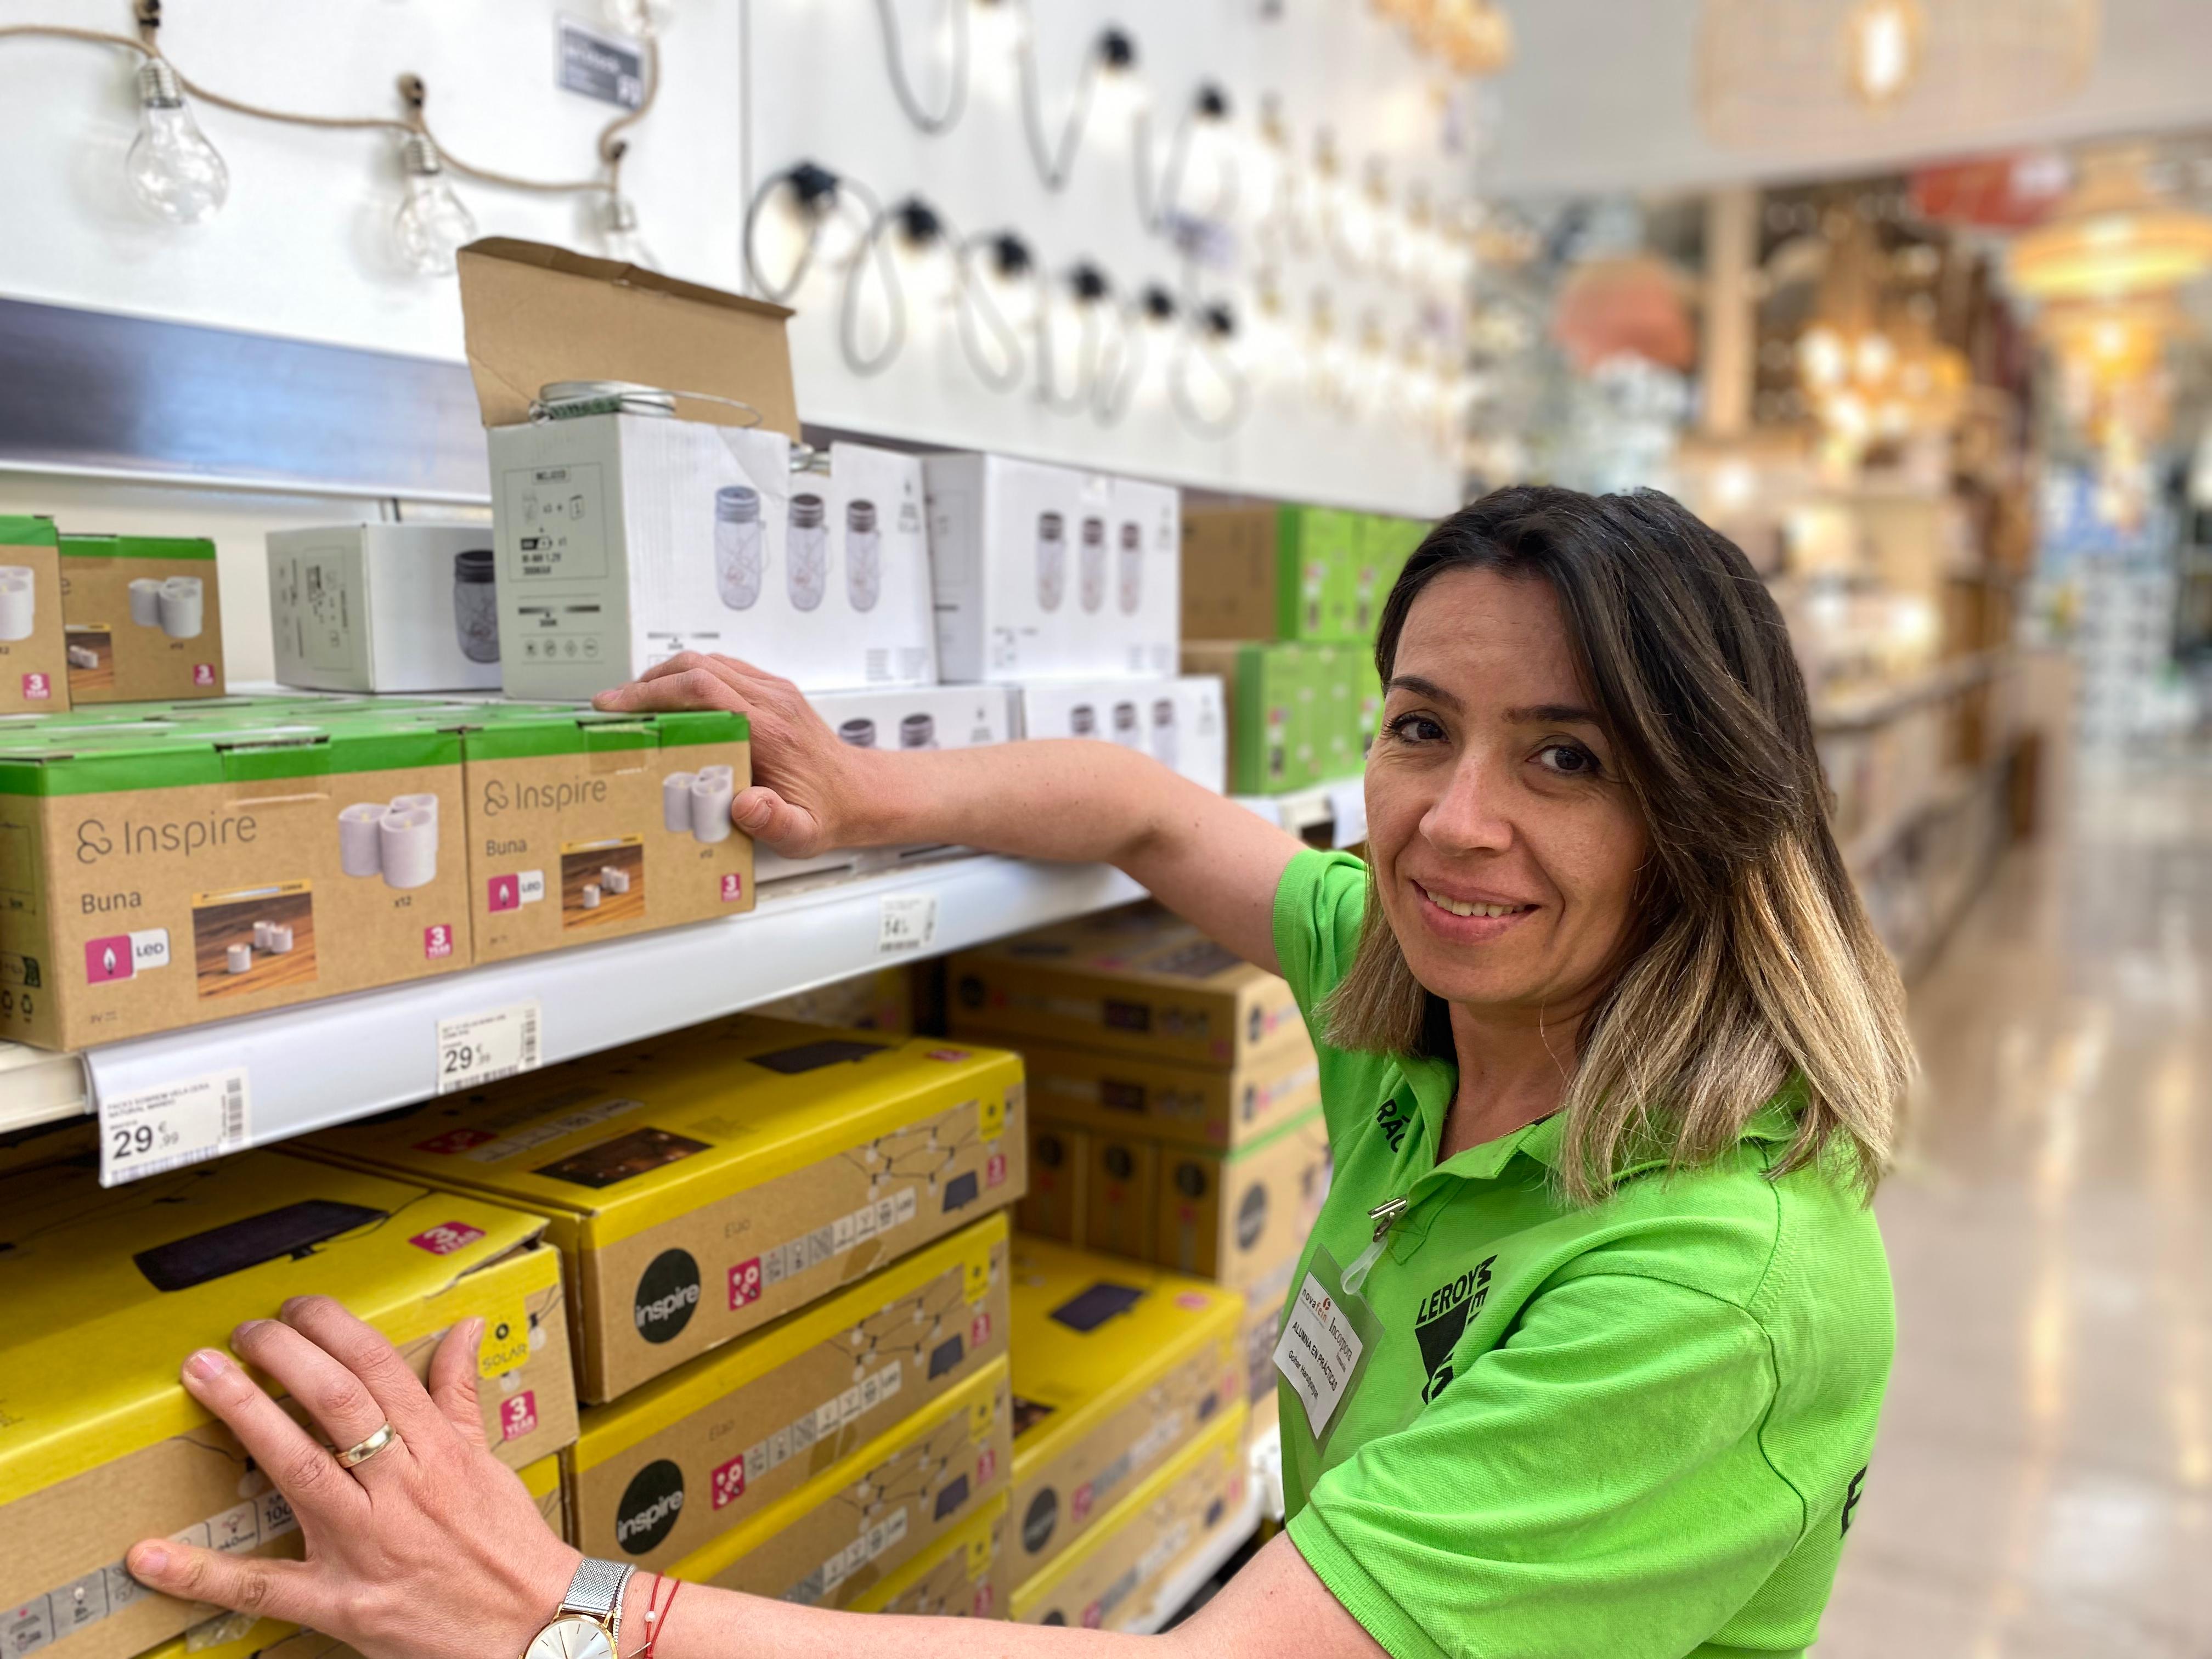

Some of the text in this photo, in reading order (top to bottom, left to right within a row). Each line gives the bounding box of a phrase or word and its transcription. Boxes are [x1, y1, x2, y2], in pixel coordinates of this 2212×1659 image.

[30, 674, 43, 690] 3
[199, 664, 210, 679] 3
[516, 775, 607, 812] Inspire
[125, 810, 257, 857] Inspire
[486, 839, 527, 857] Buna
[725, 875, 736, 891] 3
[81, 891, 142, 915] Buna
[430, 926, 446, 945] 3
[445, 1045, 472, 1074] 29
[112, 1125, 153, 1159] 29
[423, 1227, 460, 1245] 3
[635, 1282, 700, 1328] inspire
[1415, 1263, 1482, 1325] LEROY
[1329, 1317, 1353, 1362] Incorpora
[482, 1343, 527, 1371] SOLAR
[1292, 1322, 1312, 1351] ALUMNA
[1310, 1345, 1319, 1360] EN
[1317, 1353, 1338, 1391] PRÁCTICAS
[509, 1395, 527, 1422] 3
[506, 1414, 534, 1435] YEAR
[617, 1489, 684, 1543] inspire
